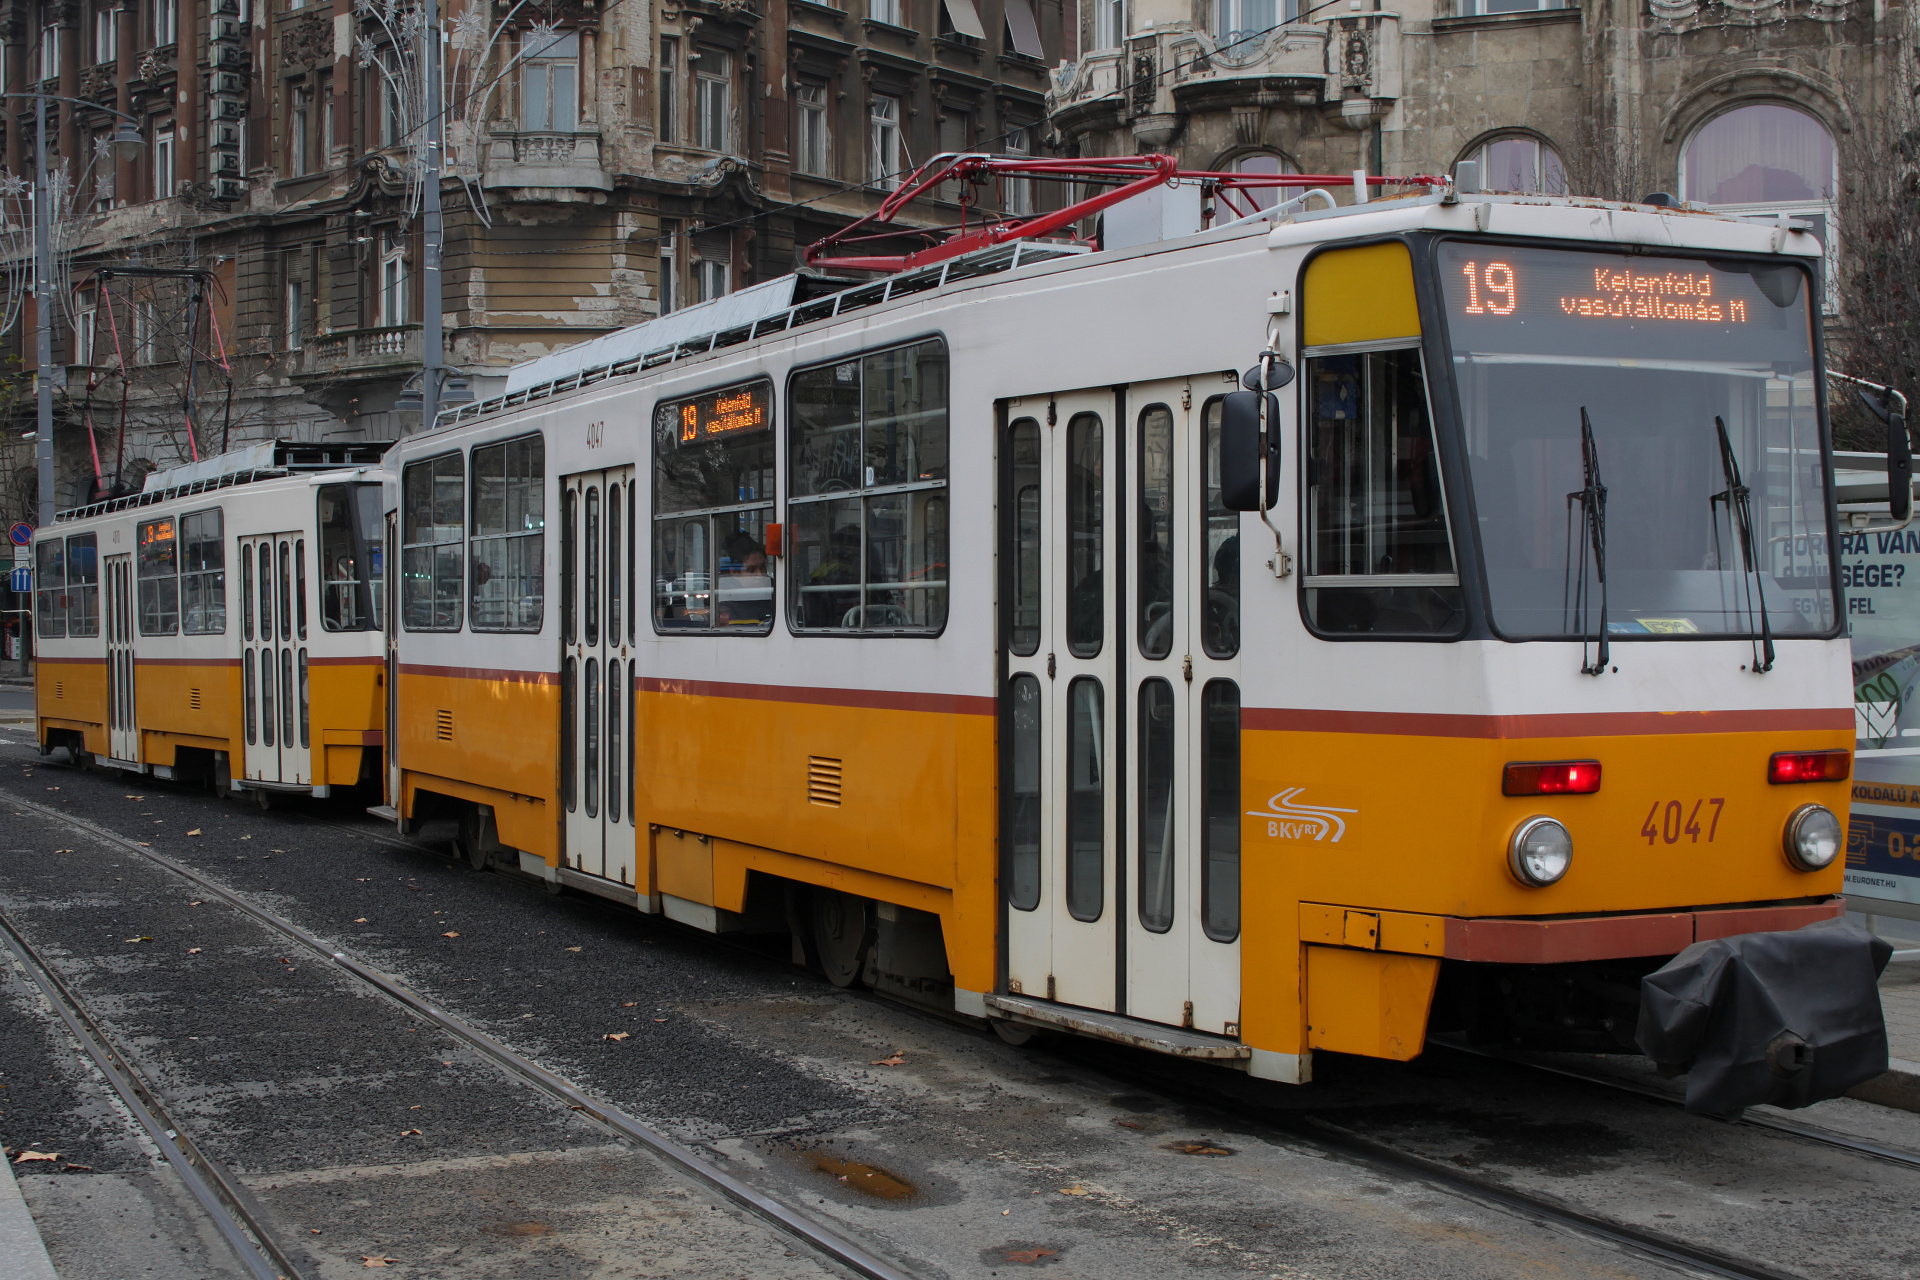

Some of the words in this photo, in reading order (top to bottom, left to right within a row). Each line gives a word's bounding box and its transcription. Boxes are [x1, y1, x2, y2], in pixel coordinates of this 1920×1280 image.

[1463, 262, 1515, 315] 19
[1594, 268, 1711, 296] Kelenföld
[1560, 294, 1723, 321] vasútállomás
[1730, 300, 1746, 322] M
[586, 421, 605, 450] 4047
[682, 405, 697, 441] 19
[1877, 530, 1920, 554] VAN
[1848, 598, 1876, 614] FEL
[1640, 797, 1725, 845] 4047
